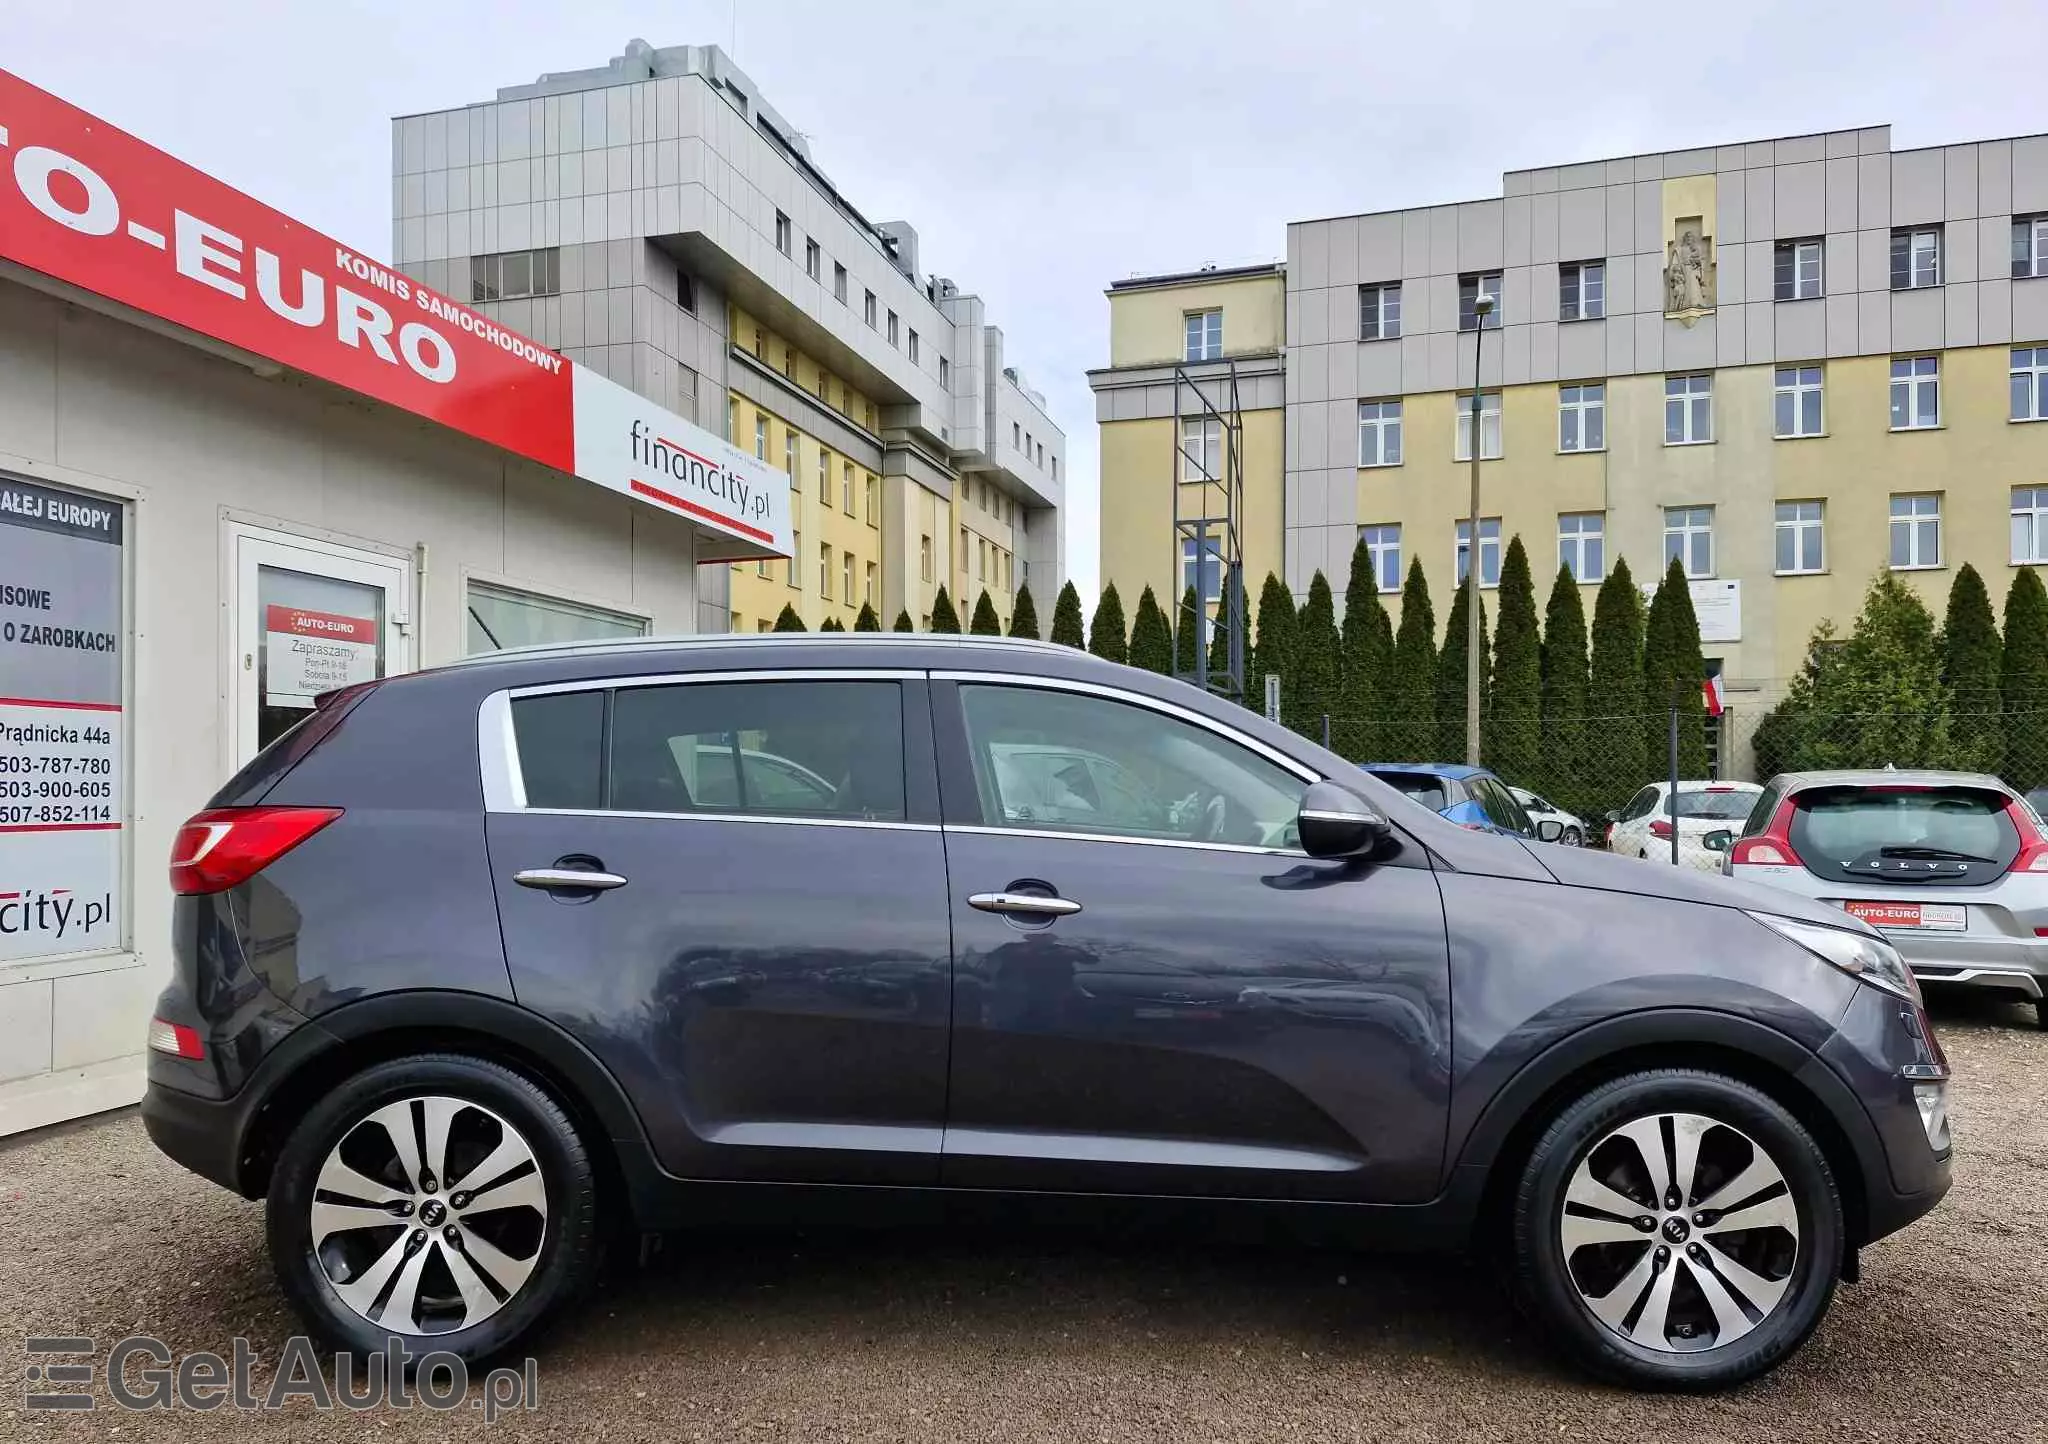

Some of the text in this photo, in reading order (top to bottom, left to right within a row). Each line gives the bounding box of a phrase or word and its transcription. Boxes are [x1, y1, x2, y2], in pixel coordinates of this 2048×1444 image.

[0, 126, 457, 384] O-EURO
[336, 247, 563, 376] KOMIS SAMOCHODOWY
[630, 419, 770, 520] financity.pl
[47, 500, 112, 531] EUROPY
[297, 616, 354, 634] AUTO-EURO
[4, 622, 116, 653] O ZAROBKACH
[83, 726, 111, 745] 44a
[0, 756, 111, 775] 503-787-780
[0, 781, 111, 798] 503-900-605
[0, 805, 111, 823] 507-852-114
[1840, 861, 1968, 871] VOLVO
[1853, 909, 1920, 919] AUTO-EURO
